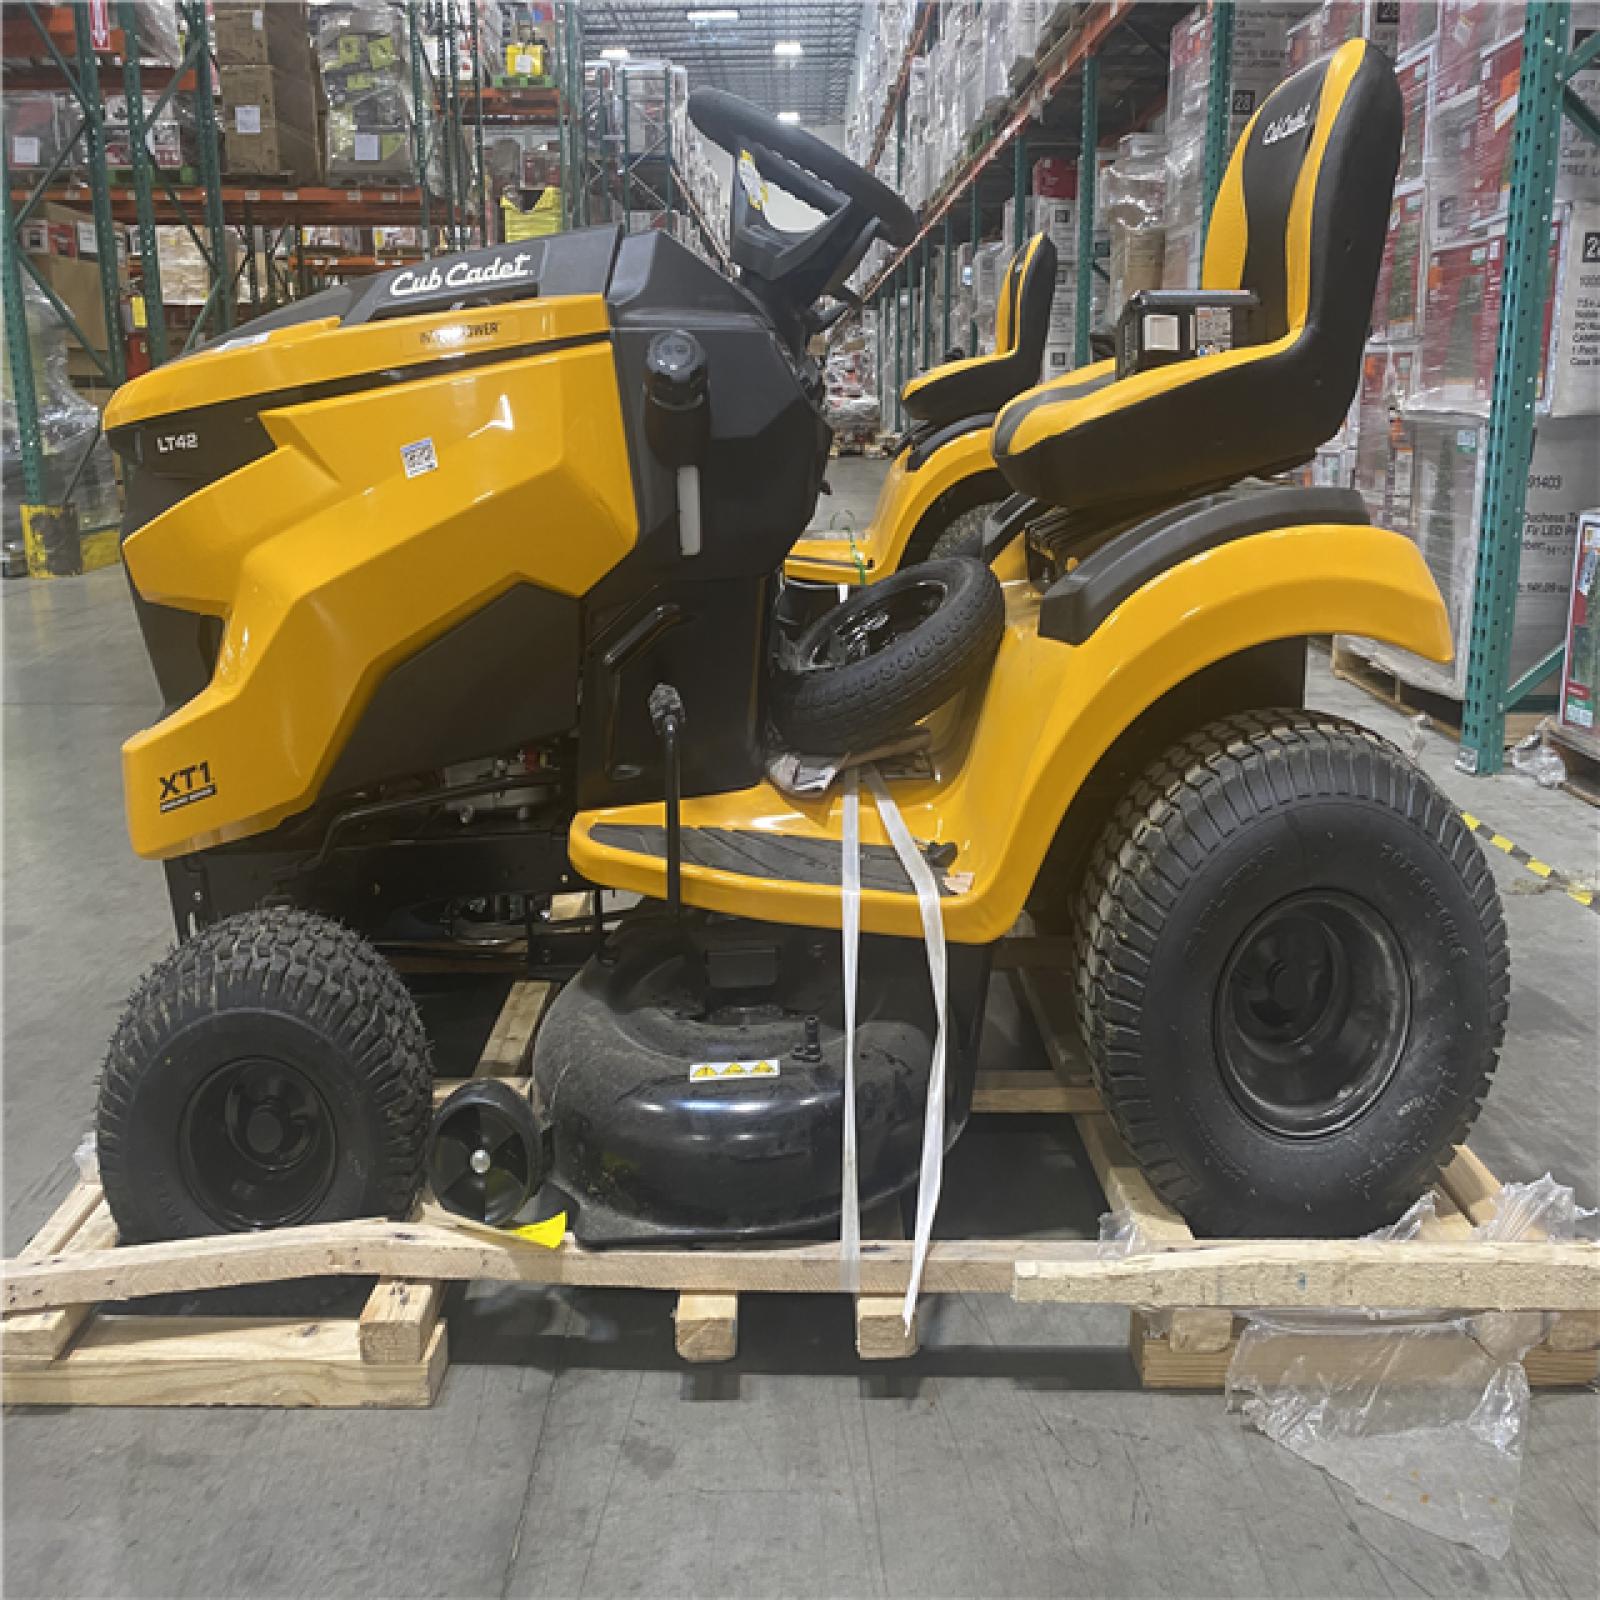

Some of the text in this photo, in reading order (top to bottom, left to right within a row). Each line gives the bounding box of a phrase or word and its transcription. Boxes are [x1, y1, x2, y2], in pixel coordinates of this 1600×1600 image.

[390, 252, 532, 297] Cub Cadet
[157, 432, 199, 453] LT42
[158, 760, 211, 801] XT1
